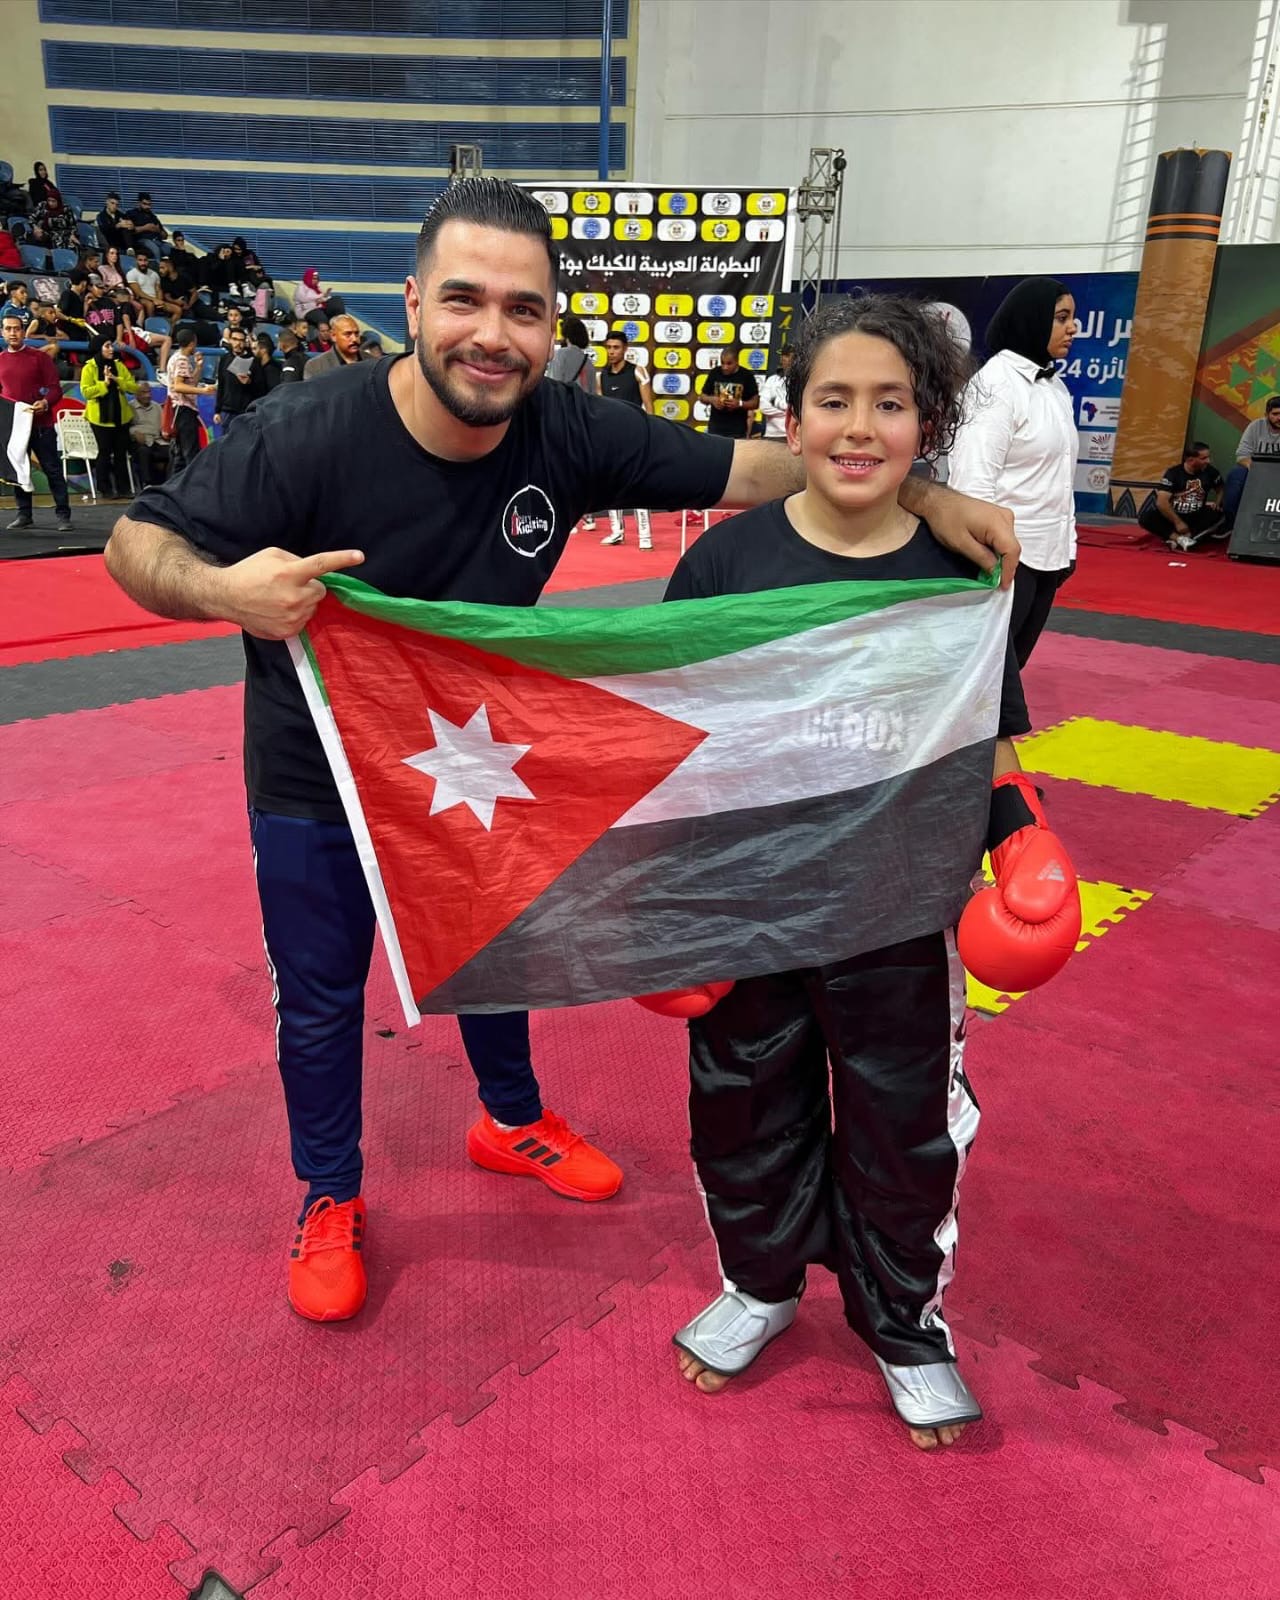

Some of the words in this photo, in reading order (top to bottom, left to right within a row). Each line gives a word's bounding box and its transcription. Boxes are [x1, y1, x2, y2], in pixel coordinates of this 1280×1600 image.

[586, 254, 637, 277] للكيك
[639, 256, 697, 279] العربية
[700, 256, 761, 279] البطولة
